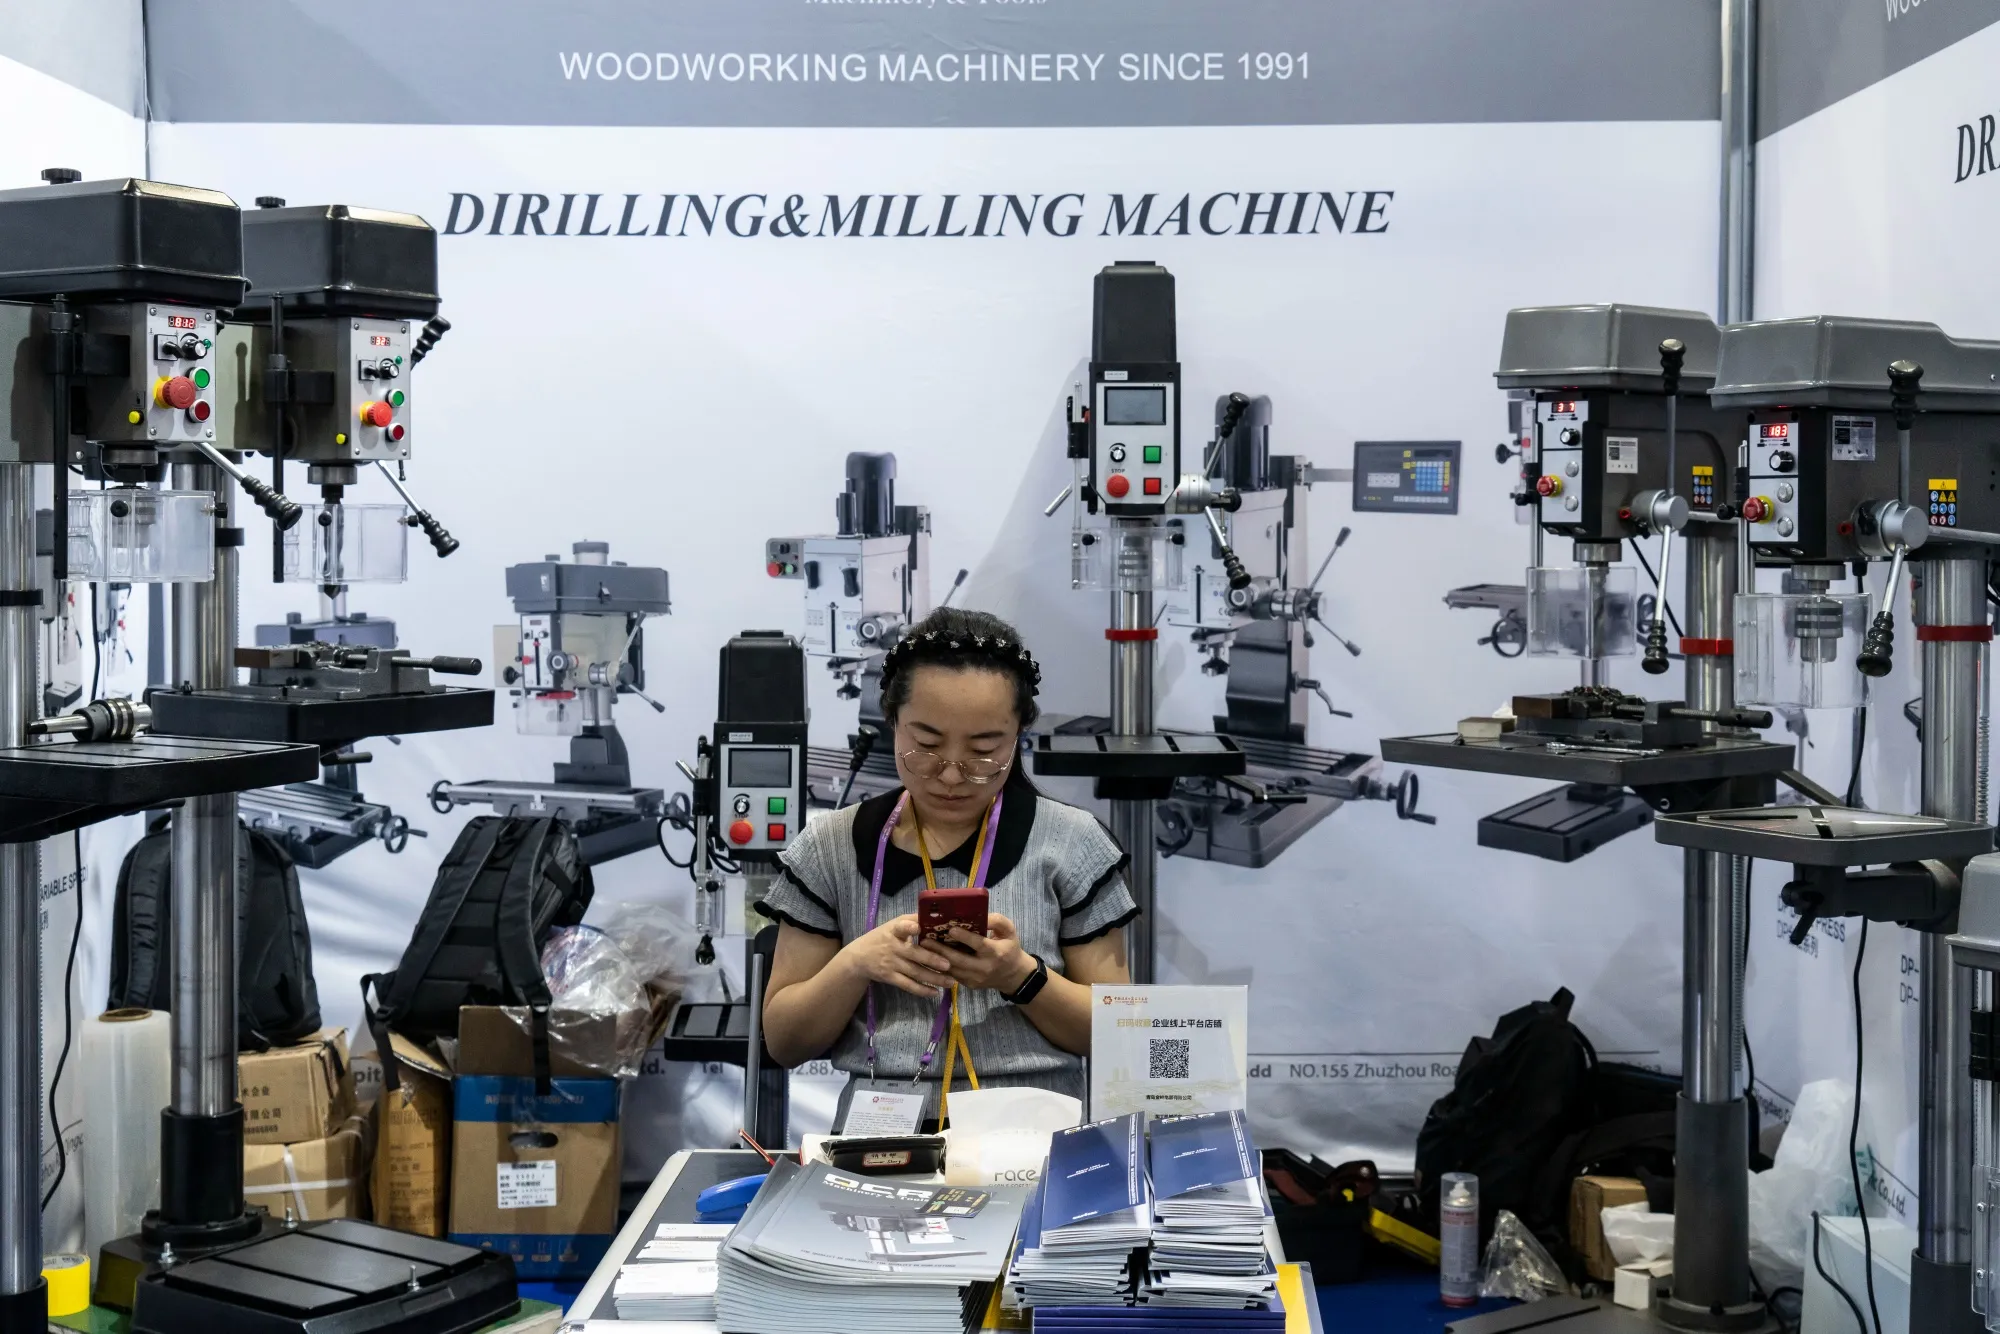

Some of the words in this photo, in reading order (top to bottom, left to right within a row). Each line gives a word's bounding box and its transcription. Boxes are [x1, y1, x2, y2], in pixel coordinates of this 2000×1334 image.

[559, 51, 867, 82] WOODWORKING
[879, 52, 1105, 82] MACHINERY
[1118, 52, 1225, 82] SINCE
[1238, 51, 1310, 81] 1991
[1954, 110, 2000, 184] DR
[442, 191, 1085, 238] DIRILLING&MILLING
[1099, 190, 1395, 237] MACHINE
[640, 1058, 665, 1075] td.
[1247, 1064, 1272, 1078] dd
[1290, 1063, 1349, 1078] NO.155
[1353, 1062, 1427, 1078] Zhuzhou
[1430, 1062, 1460, 1078] Roa
[822, 1179, 882, 1199] Machinery
